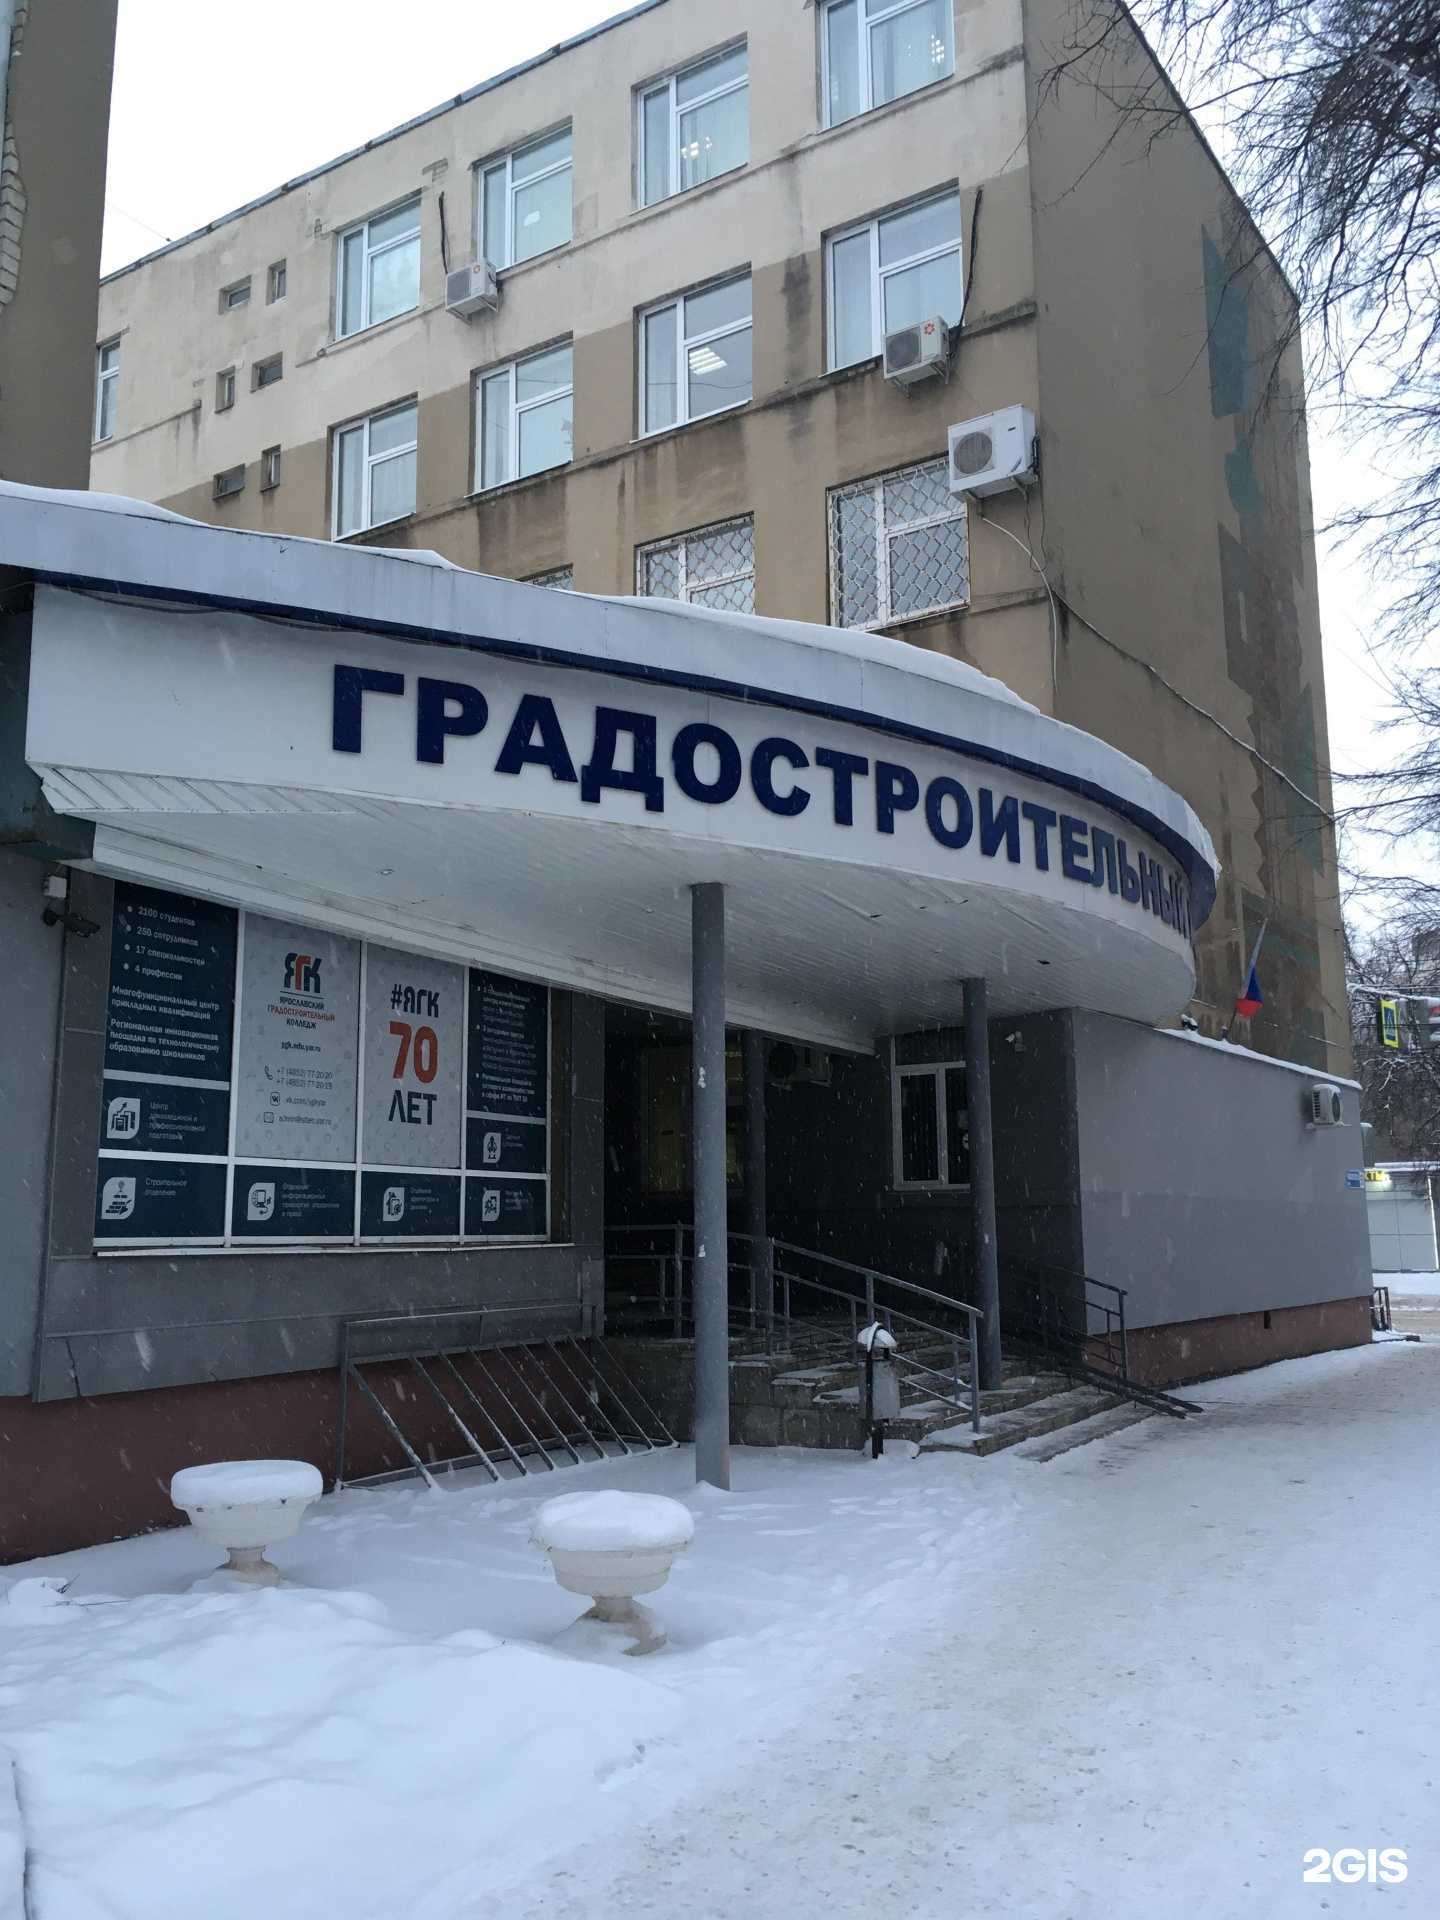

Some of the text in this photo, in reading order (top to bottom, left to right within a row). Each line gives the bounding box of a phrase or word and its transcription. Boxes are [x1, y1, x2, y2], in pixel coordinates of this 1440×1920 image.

[333, 664, 1192, 939] ГРАДОСТРОИТЕЛЬНЫЙ
[159, 912, 196, 926] студентов
[153, 932, 199, 947] сотрудников
[284, 953, 322, 993] ЯГК
[111, 998, 157, 1012] прикладных
[280, 997, 325, 1010] ЯРОСЛАВСКИЙ
[390, 983, 440, 1018] #ЯГК
[267, 1004, 336, 1022] ГРАДОСТРОИТЕЛЬНЫЙ
[110, 1019, 162, 1033] Региональная
[286, 1018, 317, 1030] КОЛЛЕДЖ
[109, 1042, 206, 1061] образованию школьников
[389, 1021, 438, 1084] 70
[388, 1089, 437, 1125] ЛЕТ
